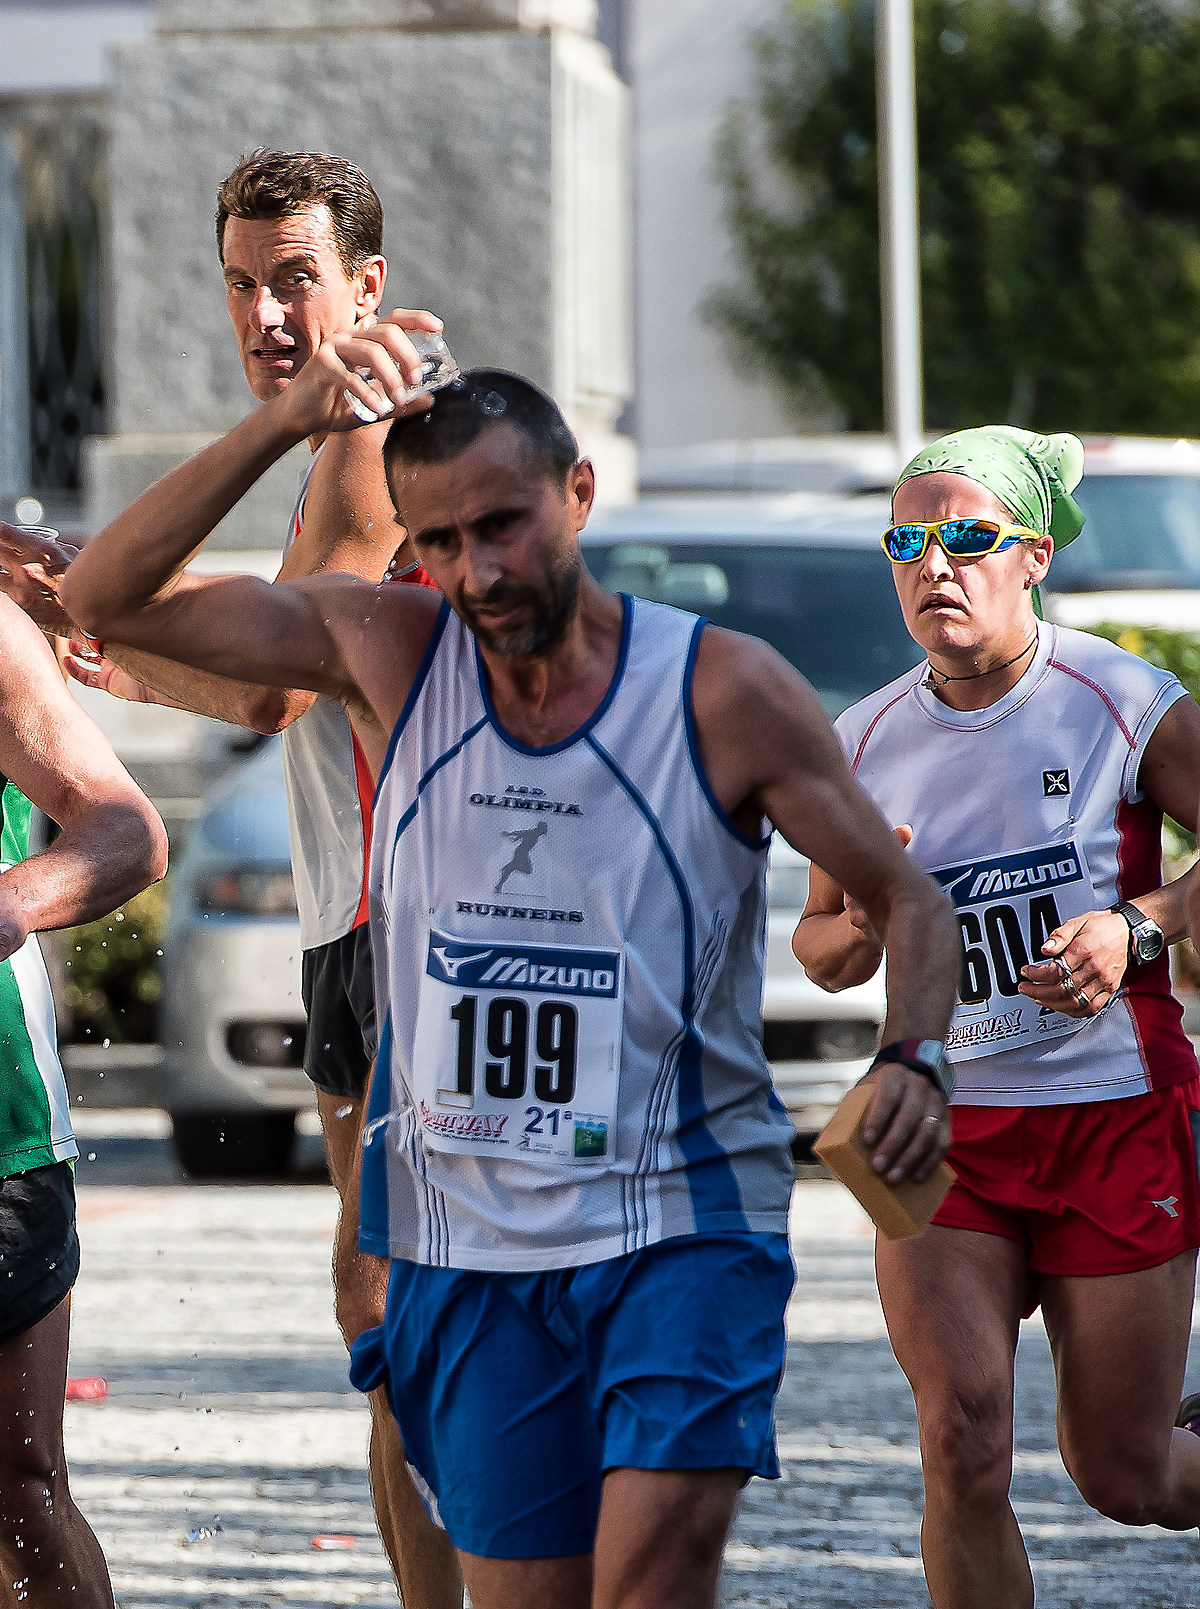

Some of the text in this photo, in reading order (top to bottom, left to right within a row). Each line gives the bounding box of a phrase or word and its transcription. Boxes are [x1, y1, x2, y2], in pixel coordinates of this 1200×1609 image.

[470, 792, 584, 815] OLIMPIA
[969, 857, 1077, 898] MIZUNO
[457, 901, 585, 922] RUNNERS
[479, 957, 615, 990] MIZUNO
[450, 995, 579, 1104] 199
